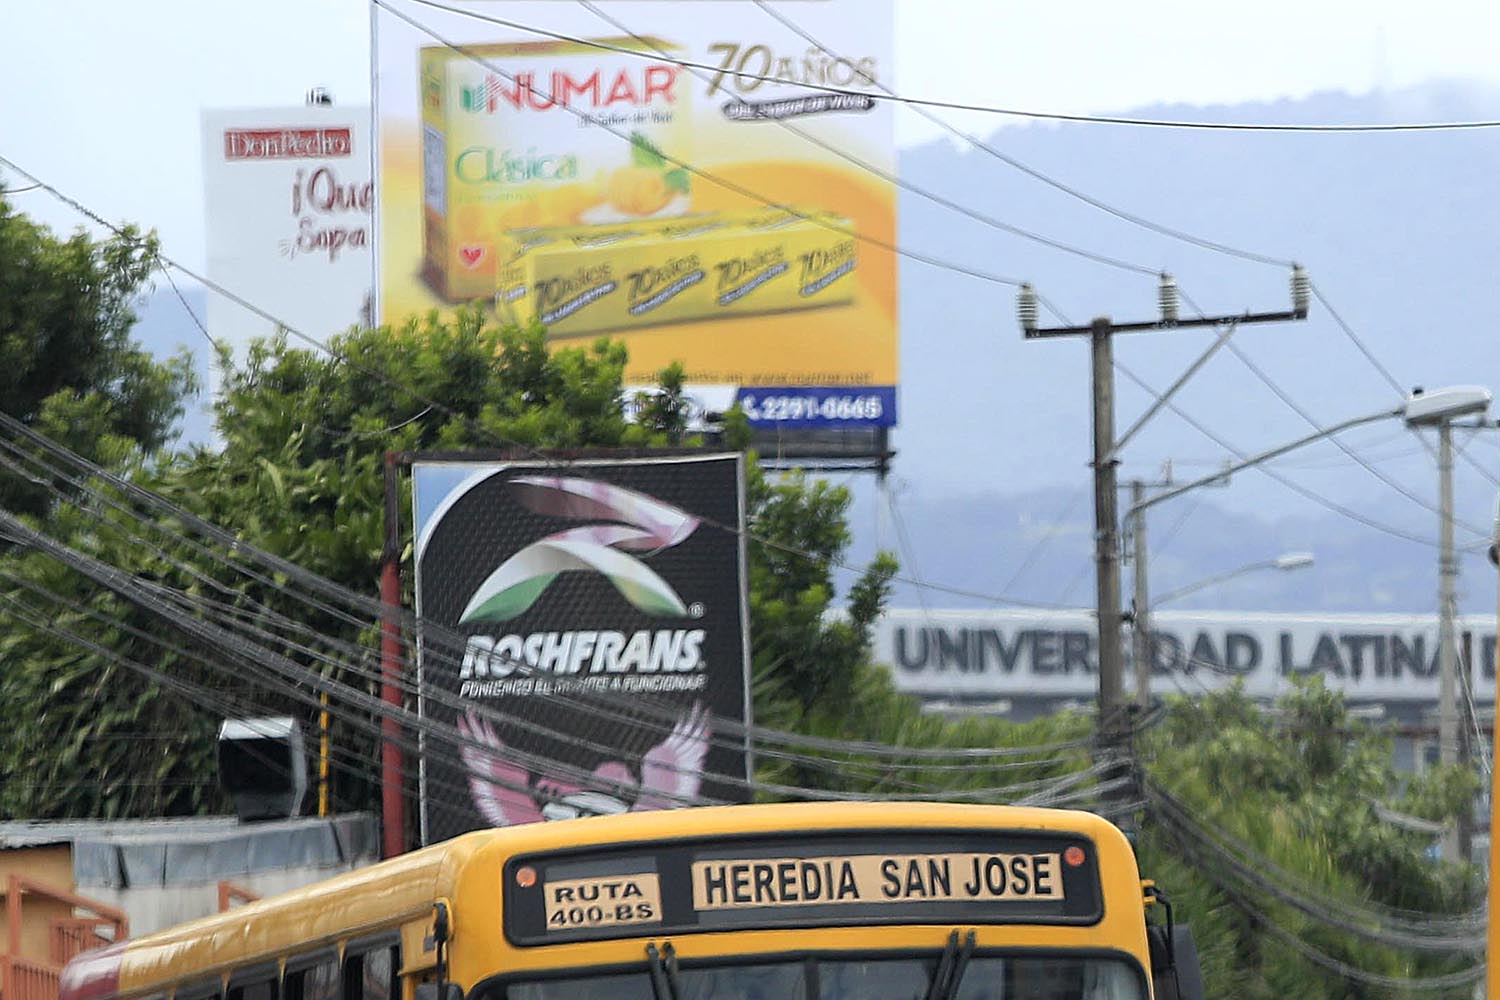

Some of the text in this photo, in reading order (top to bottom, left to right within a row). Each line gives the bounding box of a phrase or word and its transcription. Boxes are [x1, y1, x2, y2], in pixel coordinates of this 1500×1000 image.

[485, 65, 677, 114] NUMAR
[707, 42, 878, 97] 70 AÑOS
[455, 147, 578, 184] Clásica
[459, 630, 705, 679] ROSHFRANS
[894, 628, 1262, 676] UNIVERDAD
[554, 882, 643, 903] RUTA
[705, 856, 1053, 904] HEREDIA SAN JOSE
[550, 902, 654, 924] 400-BS
